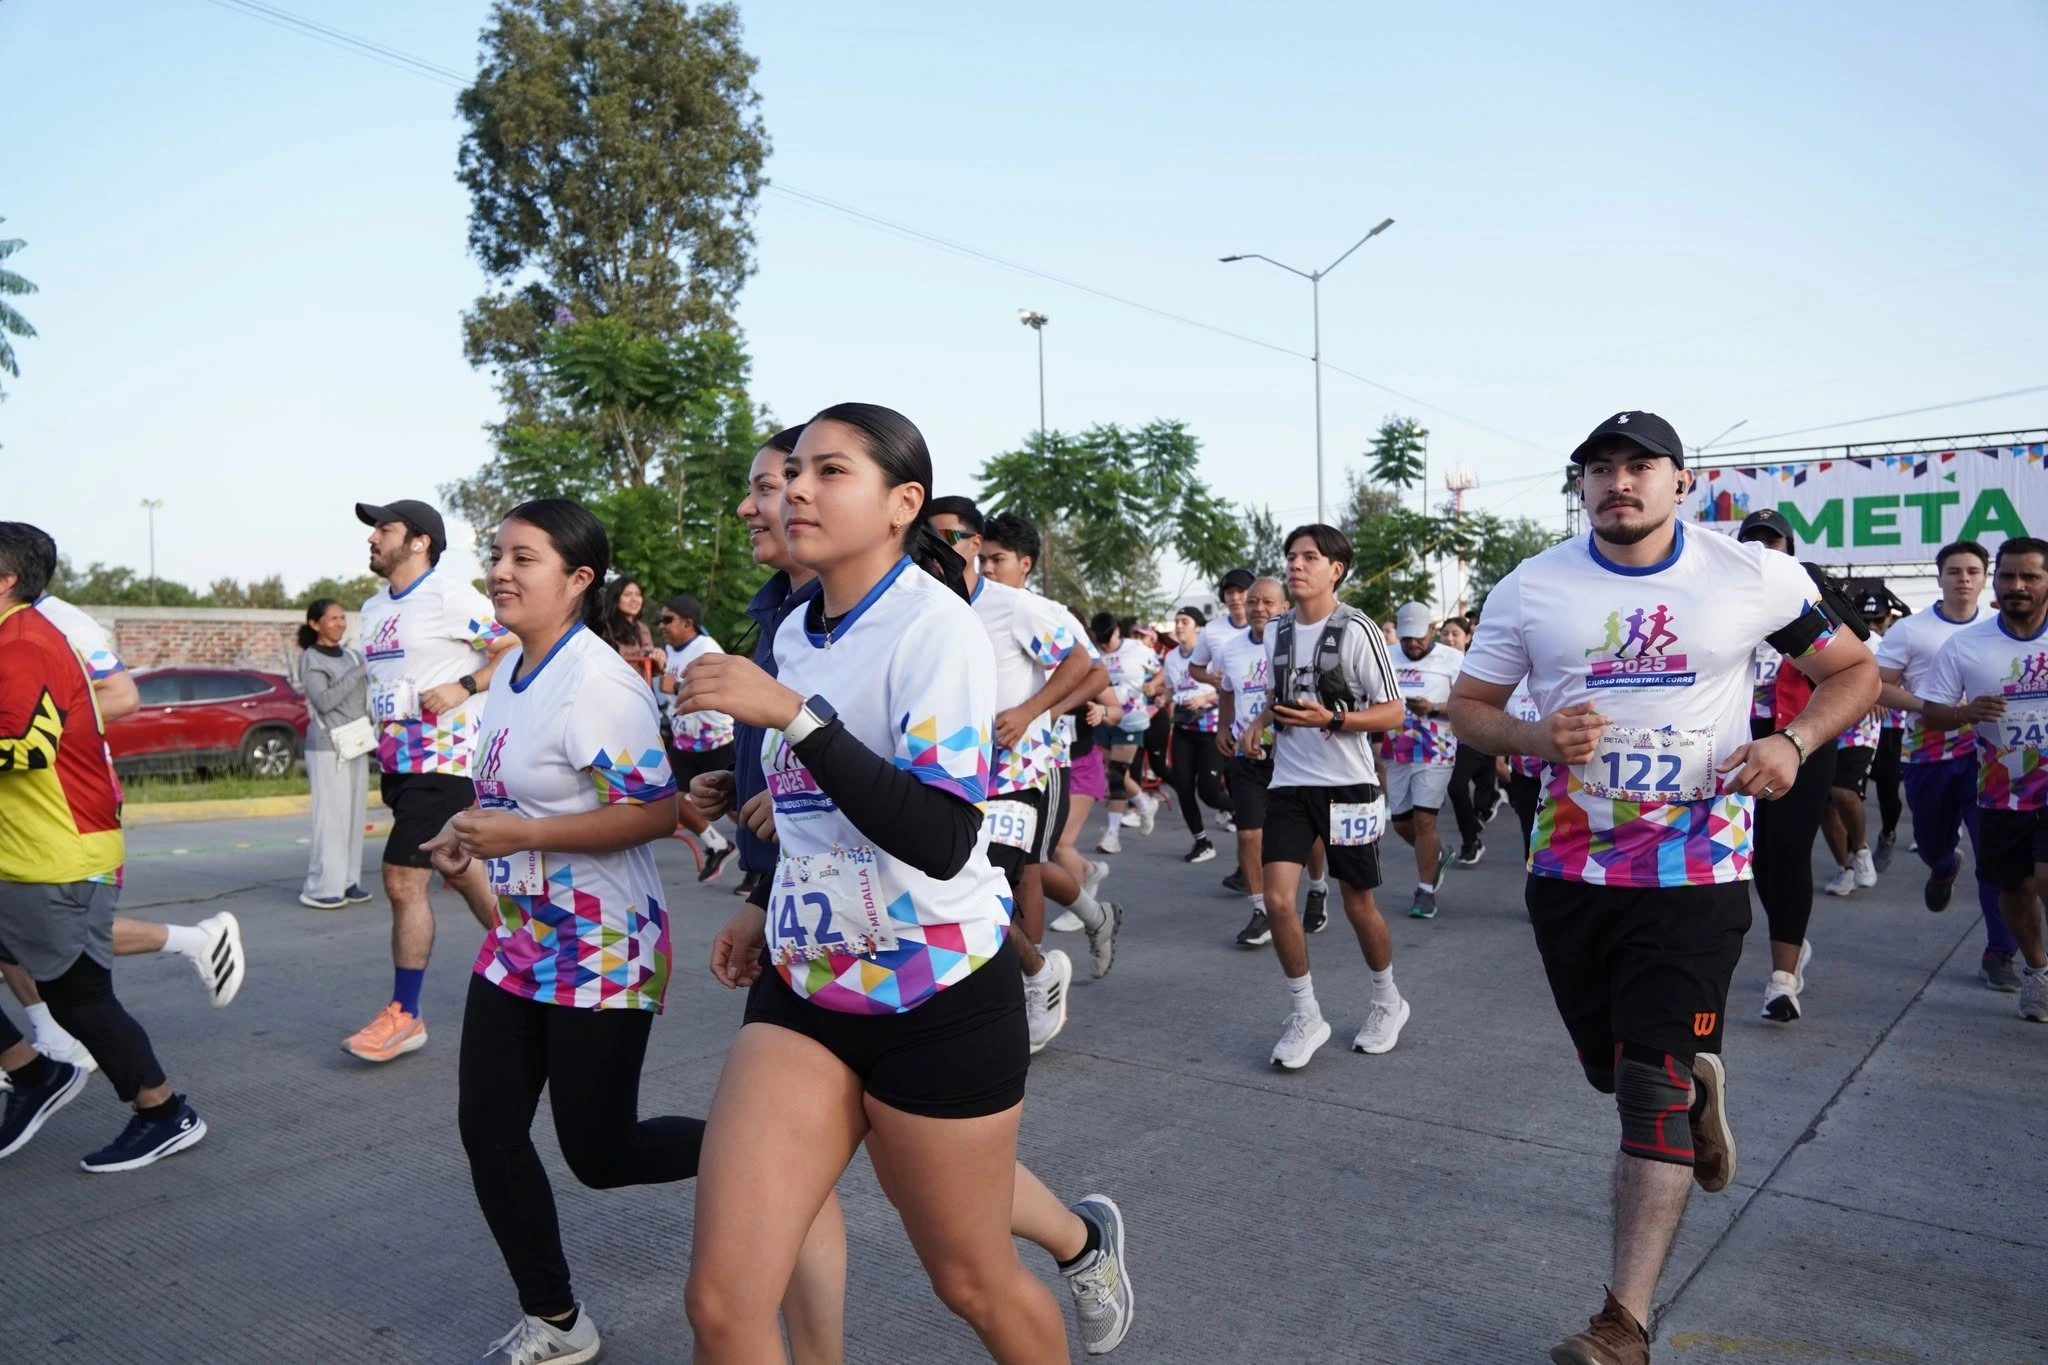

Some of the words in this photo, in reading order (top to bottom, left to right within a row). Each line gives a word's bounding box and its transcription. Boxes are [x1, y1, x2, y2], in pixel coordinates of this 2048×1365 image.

[1778, 487, 2031, 549] META
[1611, 657, 1667, 674] 2025
[1587, 678, 1615, 687] CIUDAD
[1615, 676, 1664, 684] INDUSTRIAL
[1665, 675, 1694, 683] CORRE
[2007, 724, 2048, 746] 24
[1600, 751, 1682, 792] 122
[1705, 741, 1713, 780] MEDALLA
[775, 770, 806, 794] 2025
[987, 813, 1025, 841] 193
[1340, 815, 1377, 840] 192
[851, 851, 873, 864] 142
[859, 868, 880, 927] MEDALLA
[771, 891, 845, 950] 142
